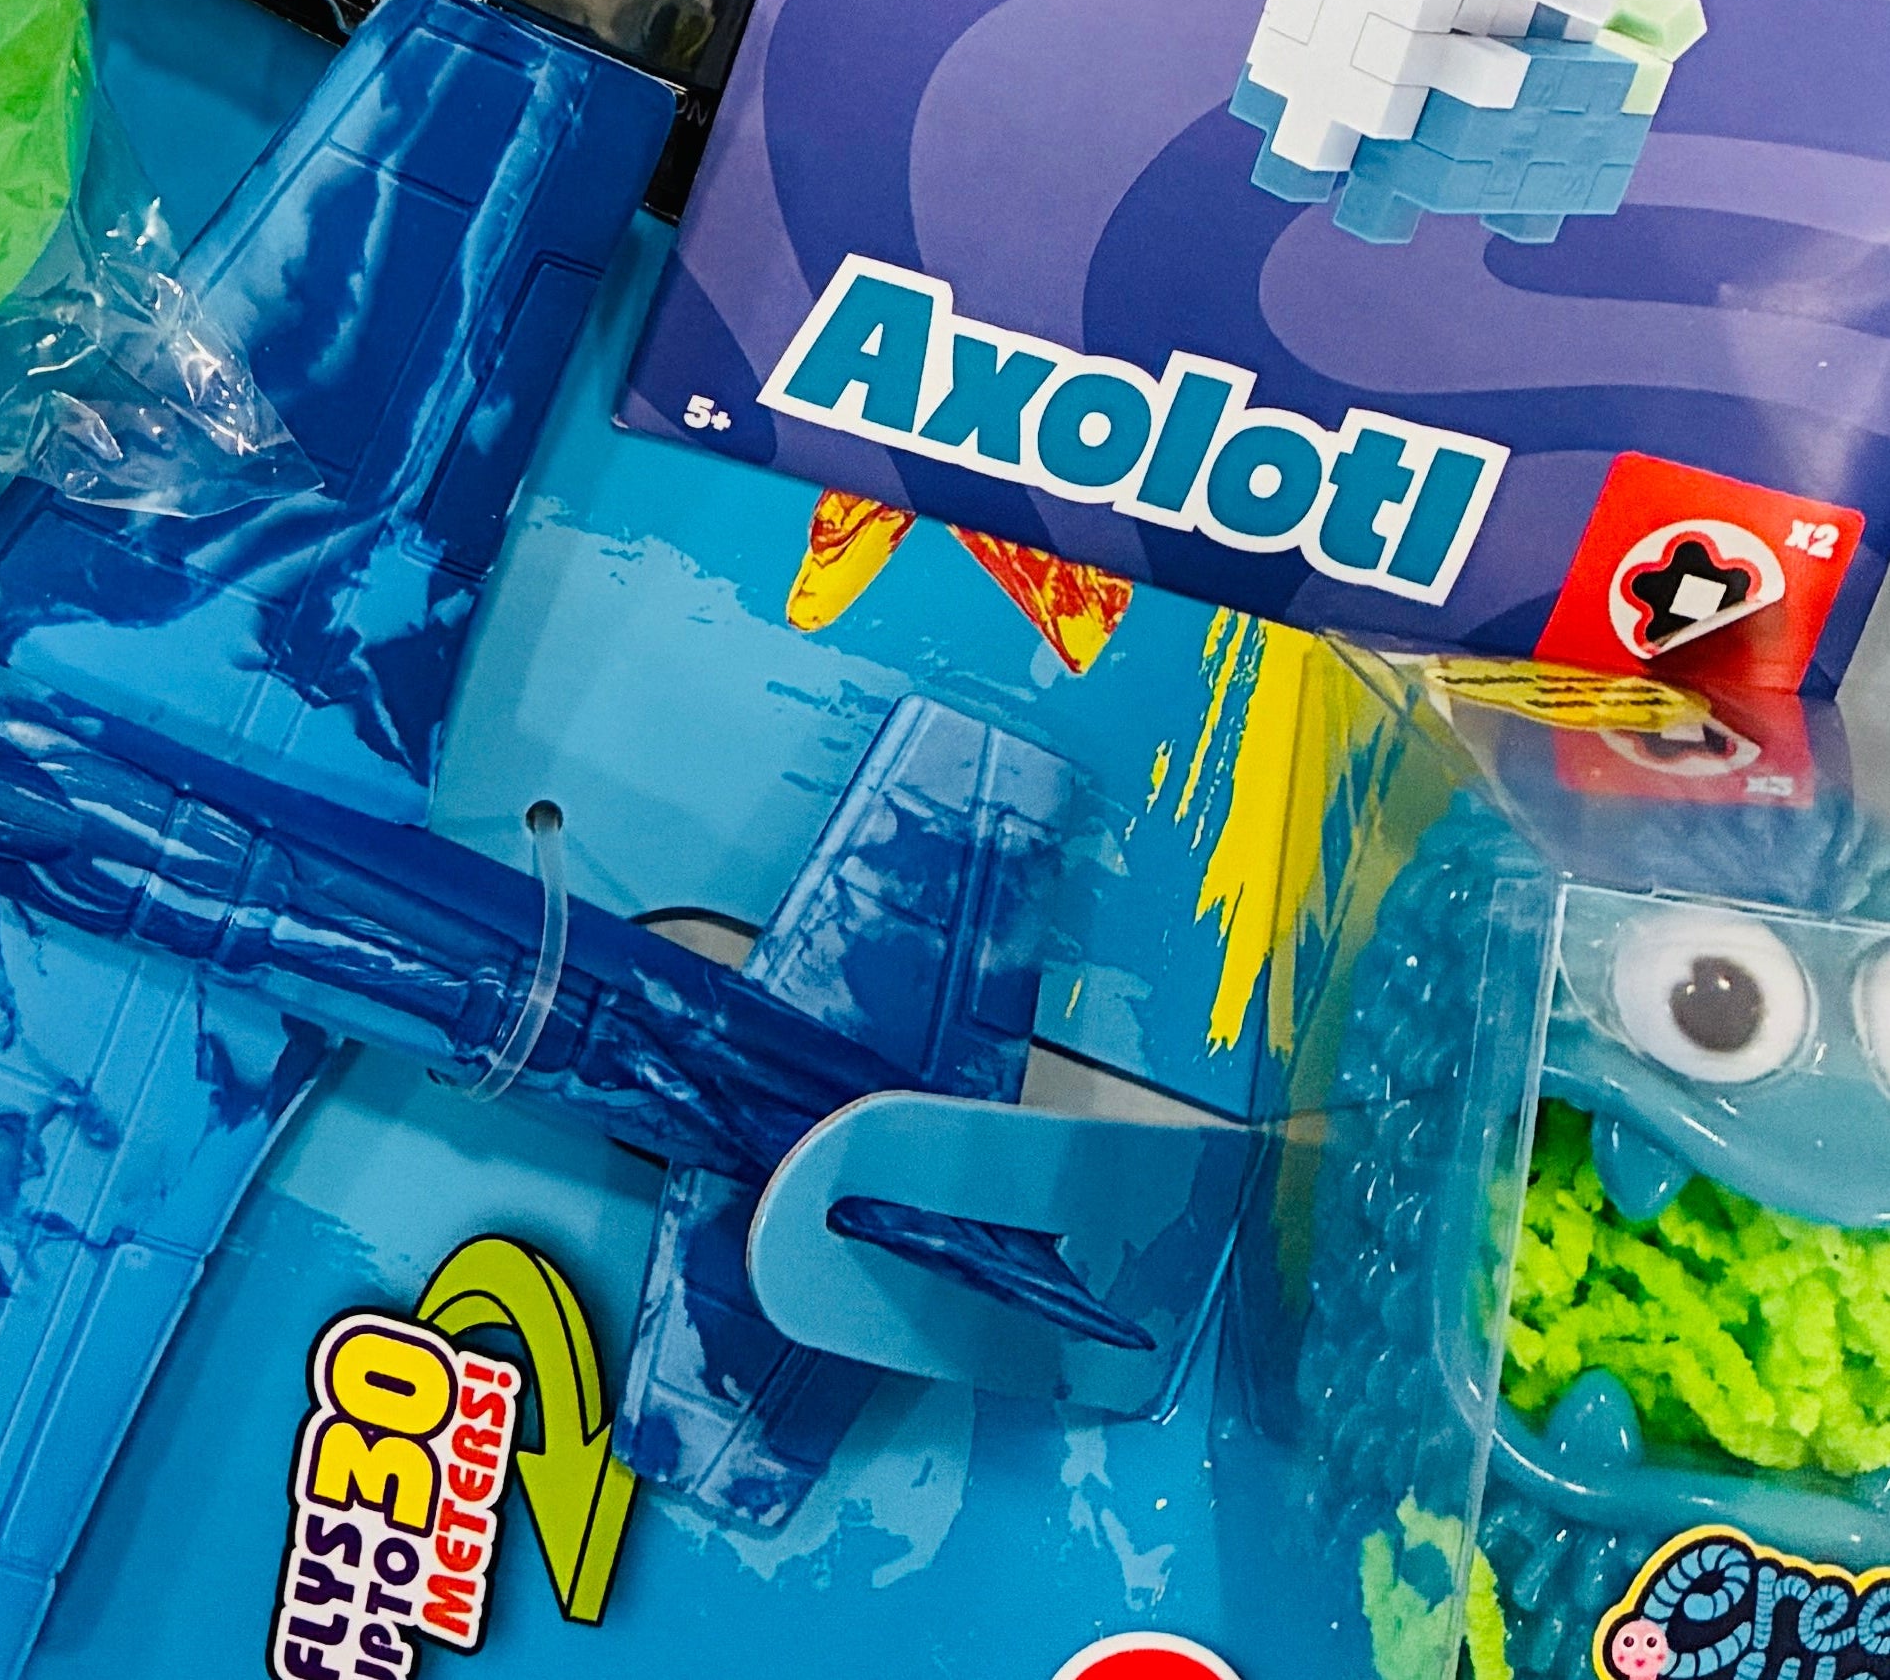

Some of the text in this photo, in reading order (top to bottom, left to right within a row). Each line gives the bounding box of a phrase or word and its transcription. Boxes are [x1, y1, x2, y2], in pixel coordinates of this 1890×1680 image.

[684, 394, 732, 435] 5+
[770, 263, 1496, 598] Axolotl
[309, 1324, 459, 1538] 30
[421, 1361, 513, 1639] METERS!
